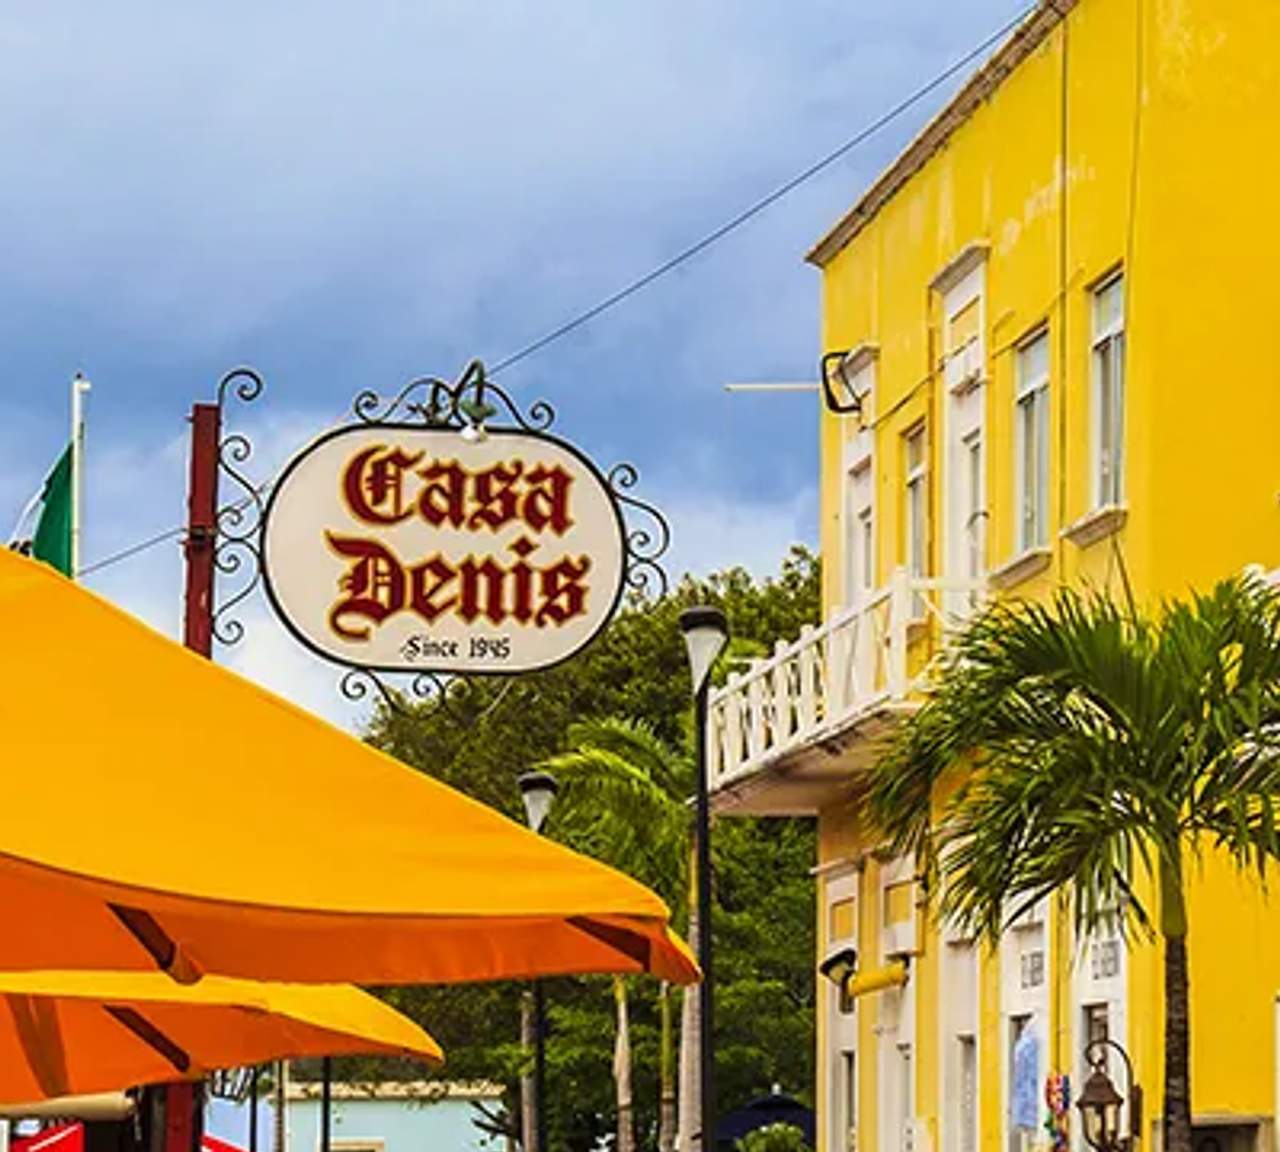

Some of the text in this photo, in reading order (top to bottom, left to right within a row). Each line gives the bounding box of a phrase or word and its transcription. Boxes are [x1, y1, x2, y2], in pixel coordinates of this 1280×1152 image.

[342, 444, 575, 535] Casa
[324, 529, 591, 641] Denis
[400, 634, 459, 662] Since
